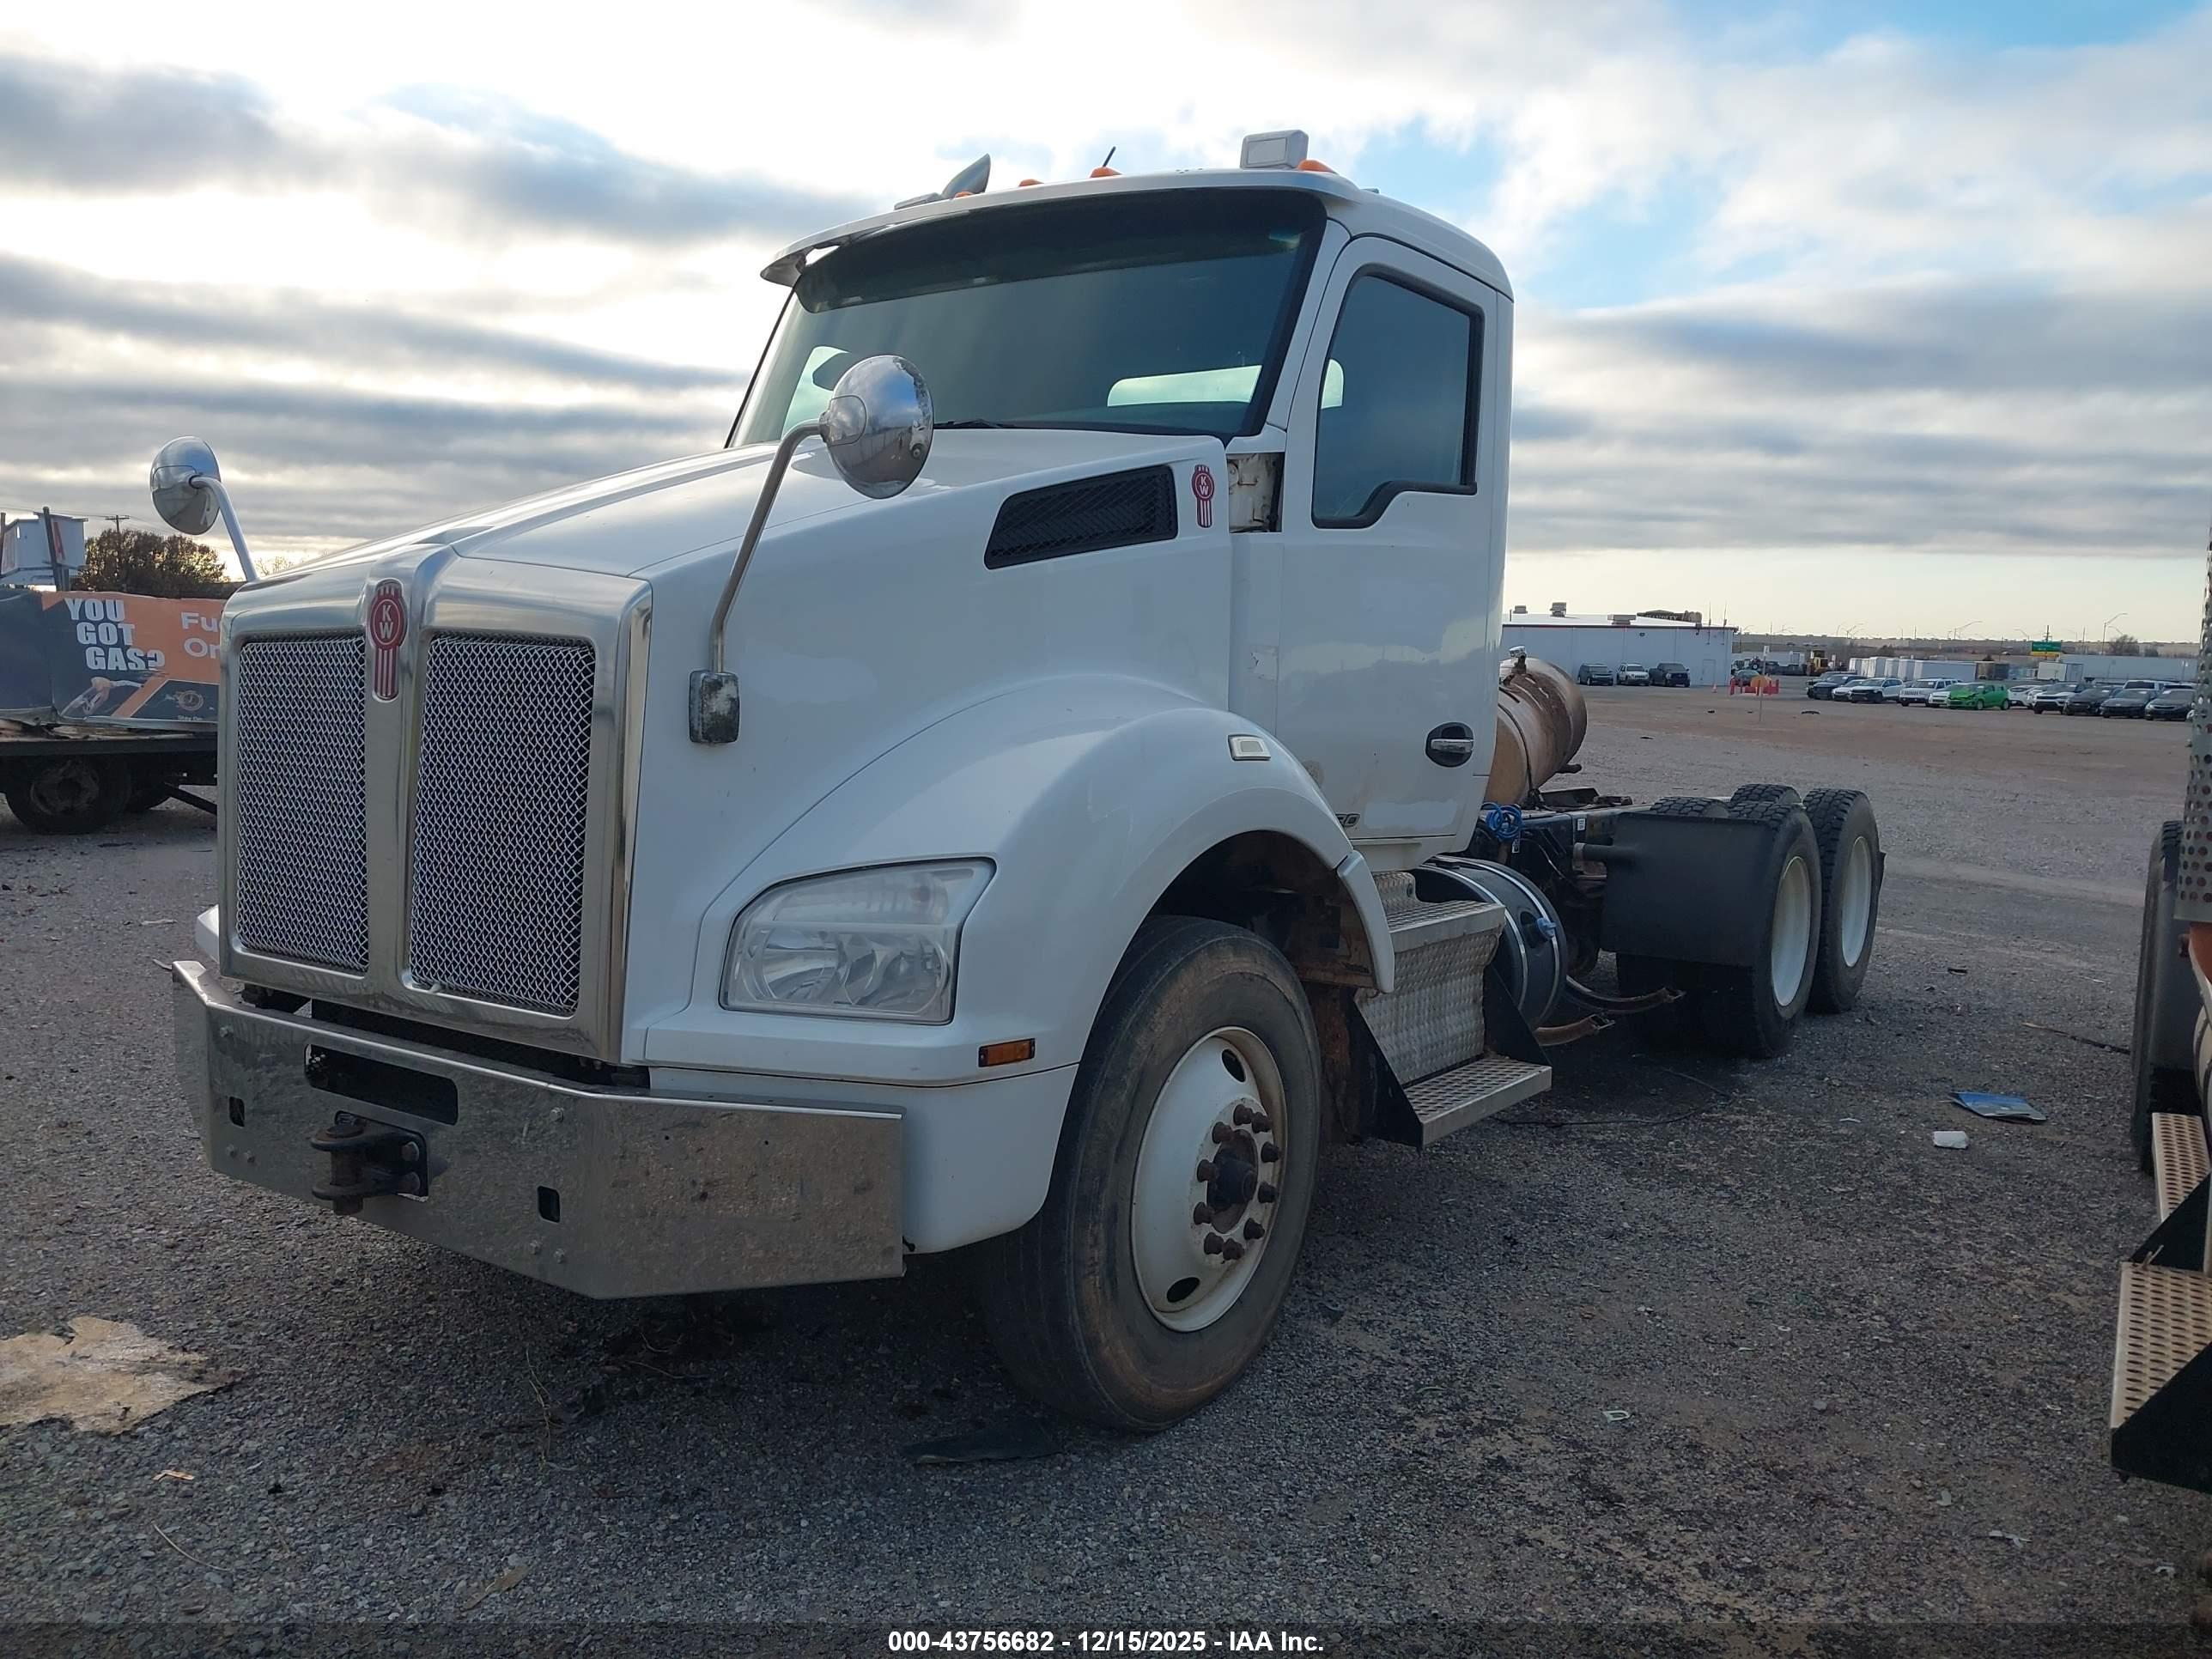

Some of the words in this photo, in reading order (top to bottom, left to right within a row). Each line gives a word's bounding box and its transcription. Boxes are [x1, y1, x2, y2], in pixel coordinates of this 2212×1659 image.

[1199, 476, 1209, 496] KW
[64, 597, 125, 623] YOU
[180, 611, 221, 633] Fu
[76, 622, 136, 646] GOT
[379, 604, 394, 641] KW
[85, 647, 166, 671] GAS?
